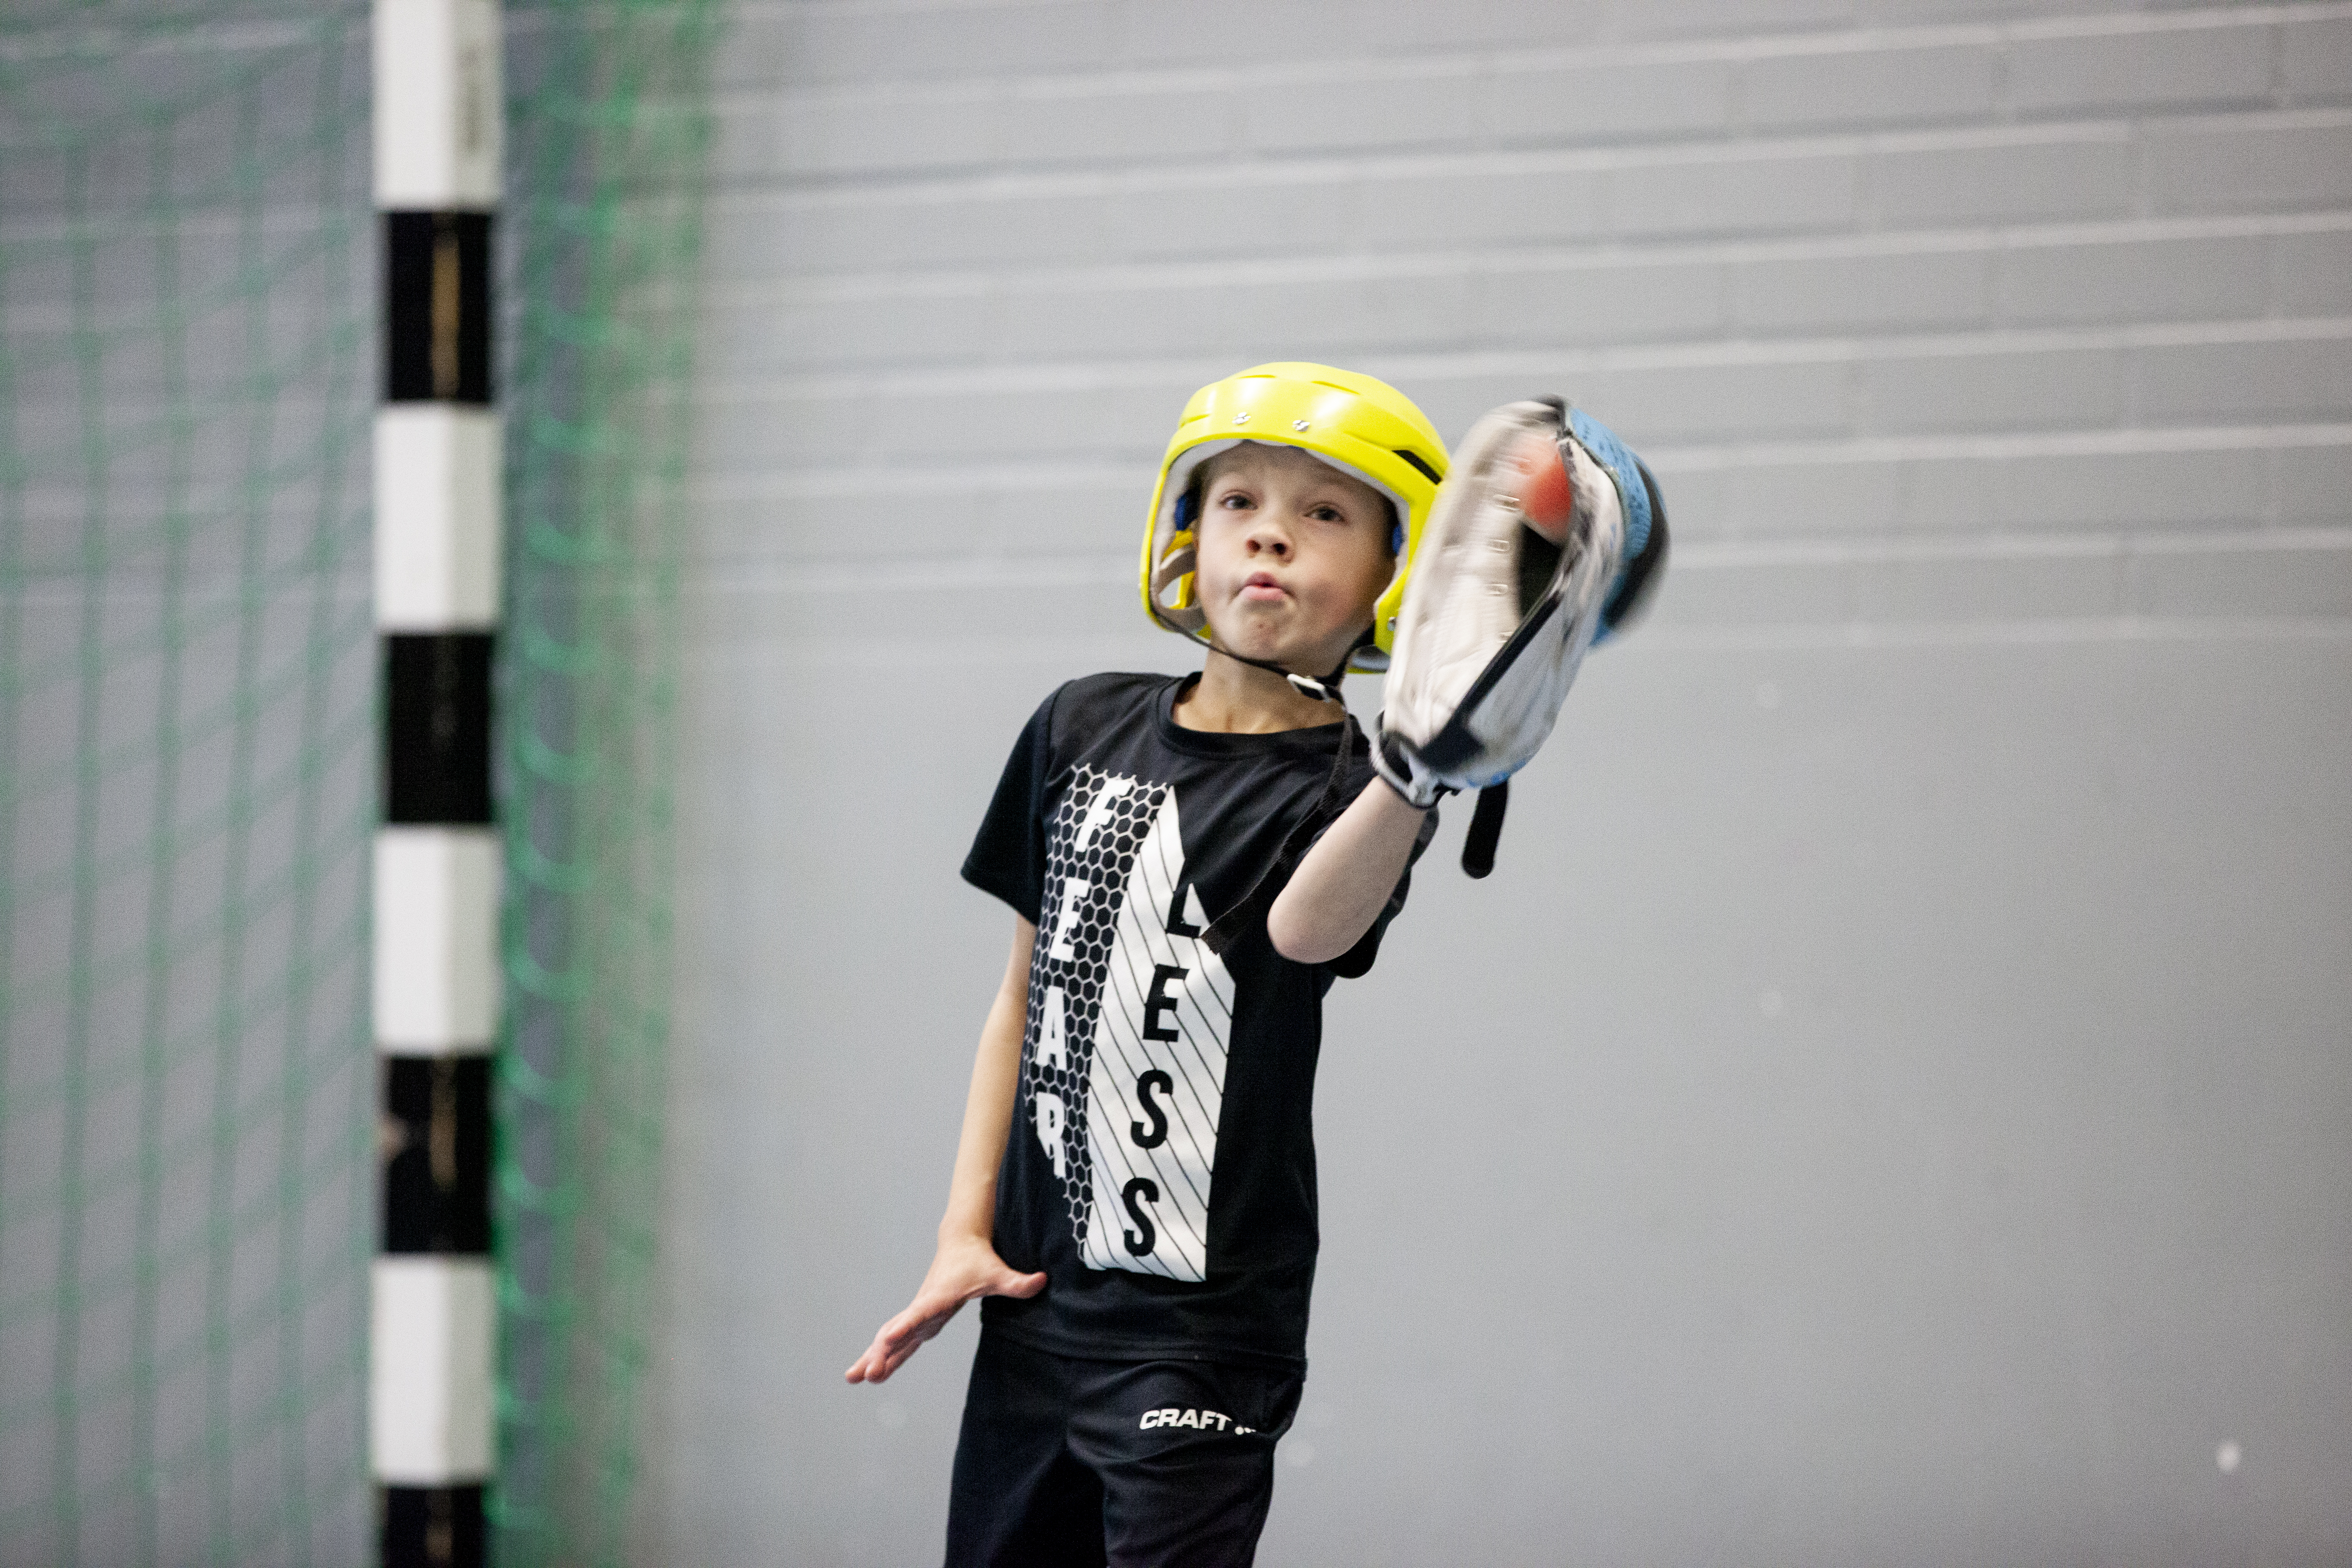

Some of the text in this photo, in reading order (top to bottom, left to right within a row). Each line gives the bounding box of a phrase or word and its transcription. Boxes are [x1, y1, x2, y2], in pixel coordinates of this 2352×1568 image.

[1035, 777, 1132, 1178] FEAR
[1122, 883, 1201, 1257] LESS
[1139, 1408, 1233, 1431] CRAFT
